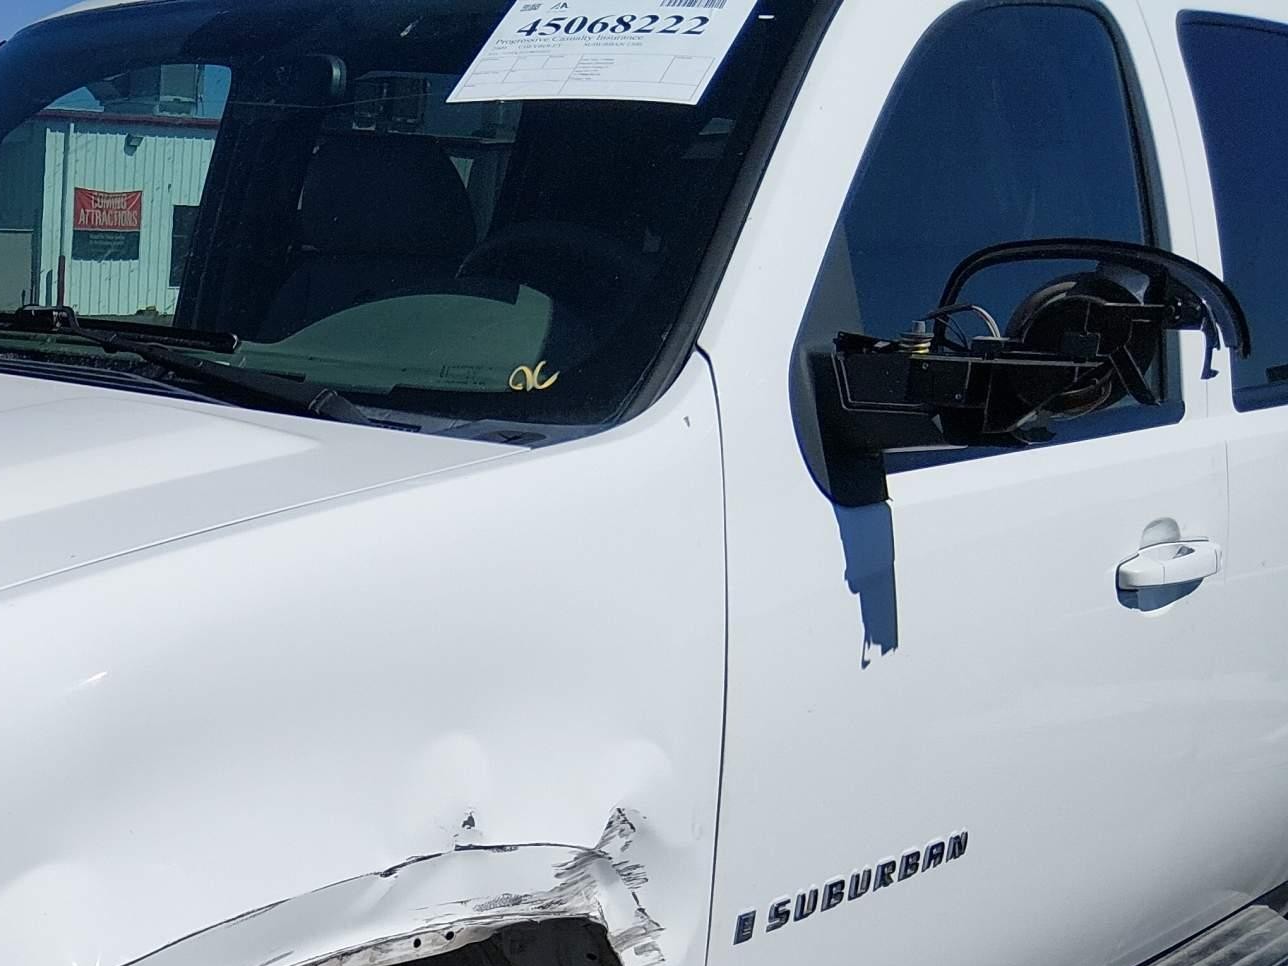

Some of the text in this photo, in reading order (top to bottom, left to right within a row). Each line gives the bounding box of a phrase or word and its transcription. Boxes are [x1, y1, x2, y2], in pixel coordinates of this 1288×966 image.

[517, 14, 710, 36] 45068222
[91, 193, 127, 209] COMING
[78, 208, 138, 226] ATTRACTIONS
[765, 829, 969, 933] SUBURBAN
